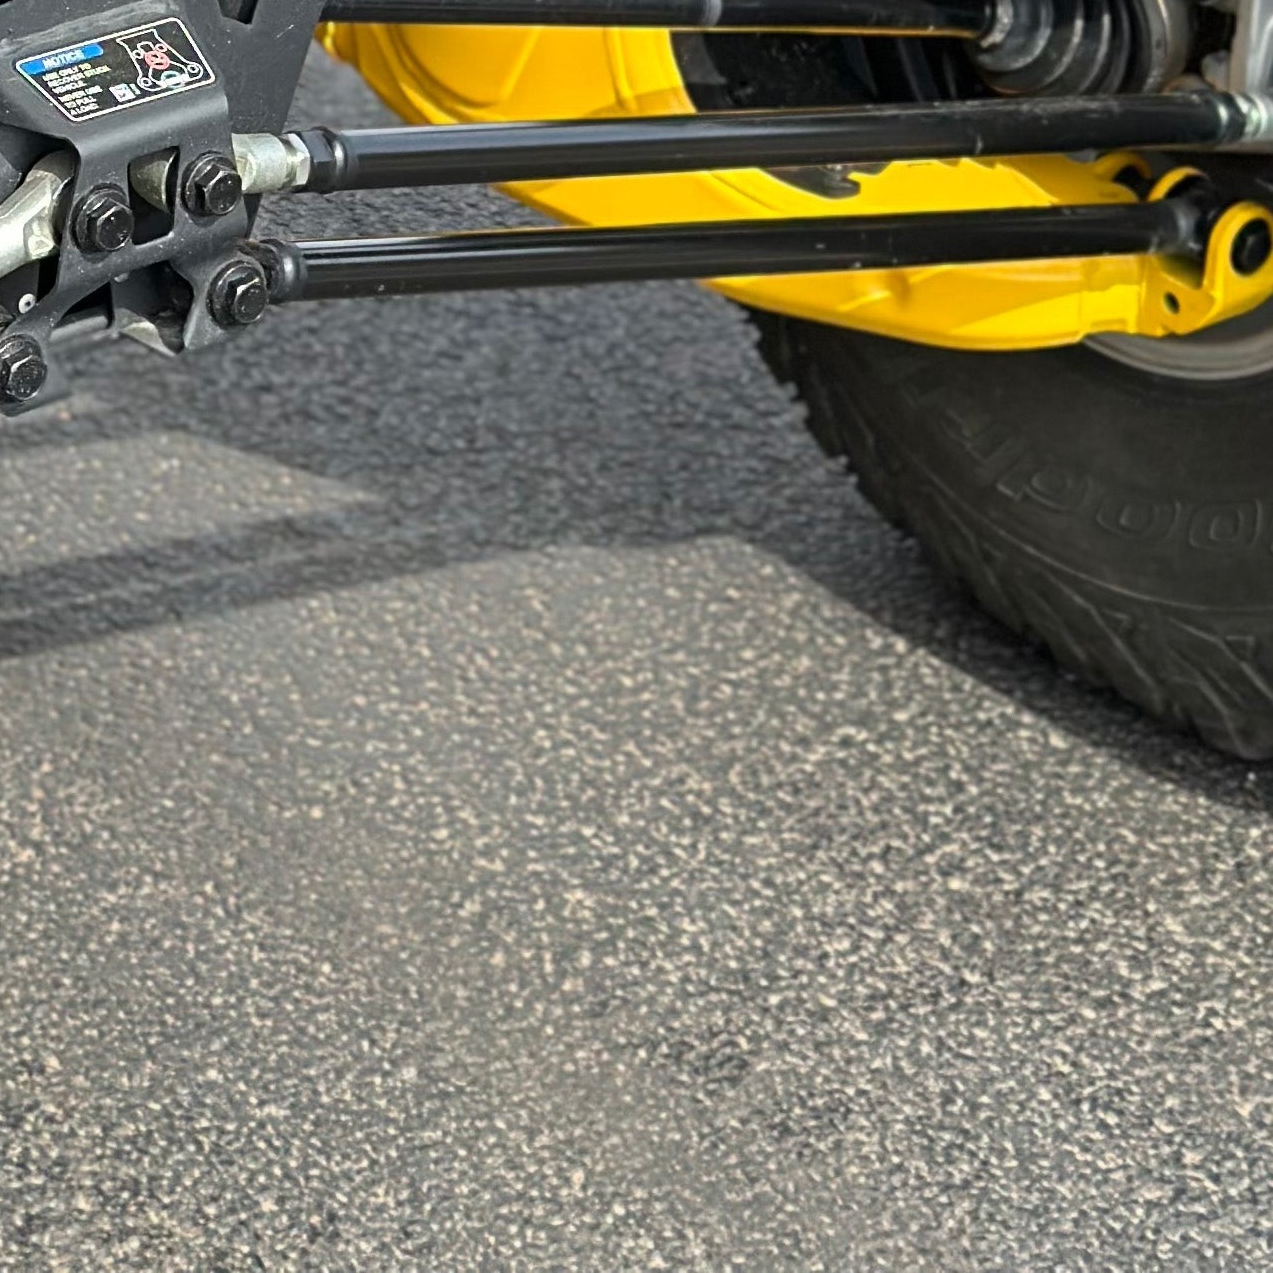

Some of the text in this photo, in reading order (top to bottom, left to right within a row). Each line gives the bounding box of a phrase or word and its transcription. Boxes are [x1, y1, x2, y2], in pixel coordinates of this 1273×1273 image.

[42, 49, 85, 69] NOTICE
[47, 65, 112, 88] RECOVER STUCK
[59, 66, 78, 77] ONLY
[78, 63, 92, 71] TO
[58, 90, 86, 103] NEVER
[64, 96, 97, 109] TO PULL
